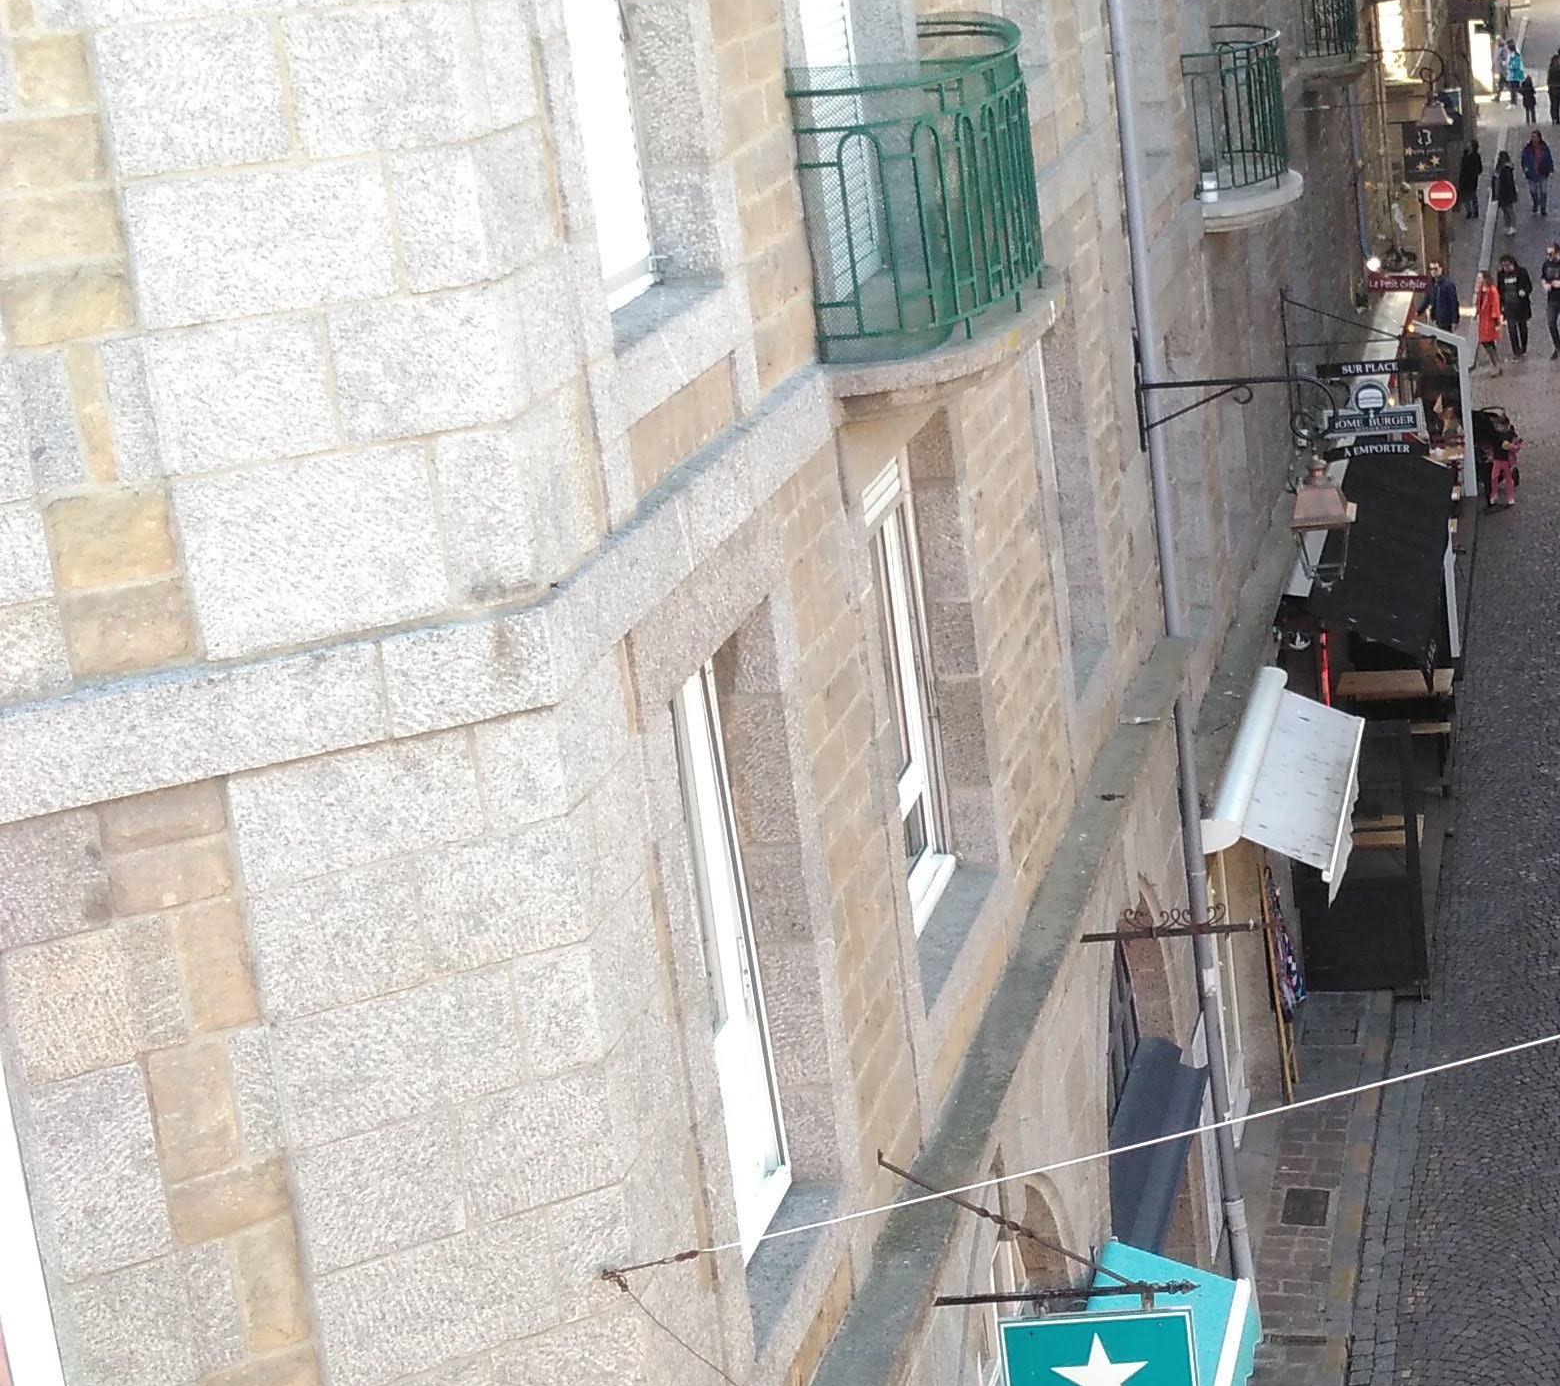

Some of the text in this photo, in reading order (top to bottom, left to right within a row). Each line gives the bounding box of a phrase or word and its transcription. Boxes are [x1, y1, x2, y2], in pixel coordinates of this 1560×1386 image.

[1341, 361, 1398, 375] SUR PLACE
[1369, 415, 1414, 427] BURGER
[1353, 444, 1410, 456] EMPORTER
